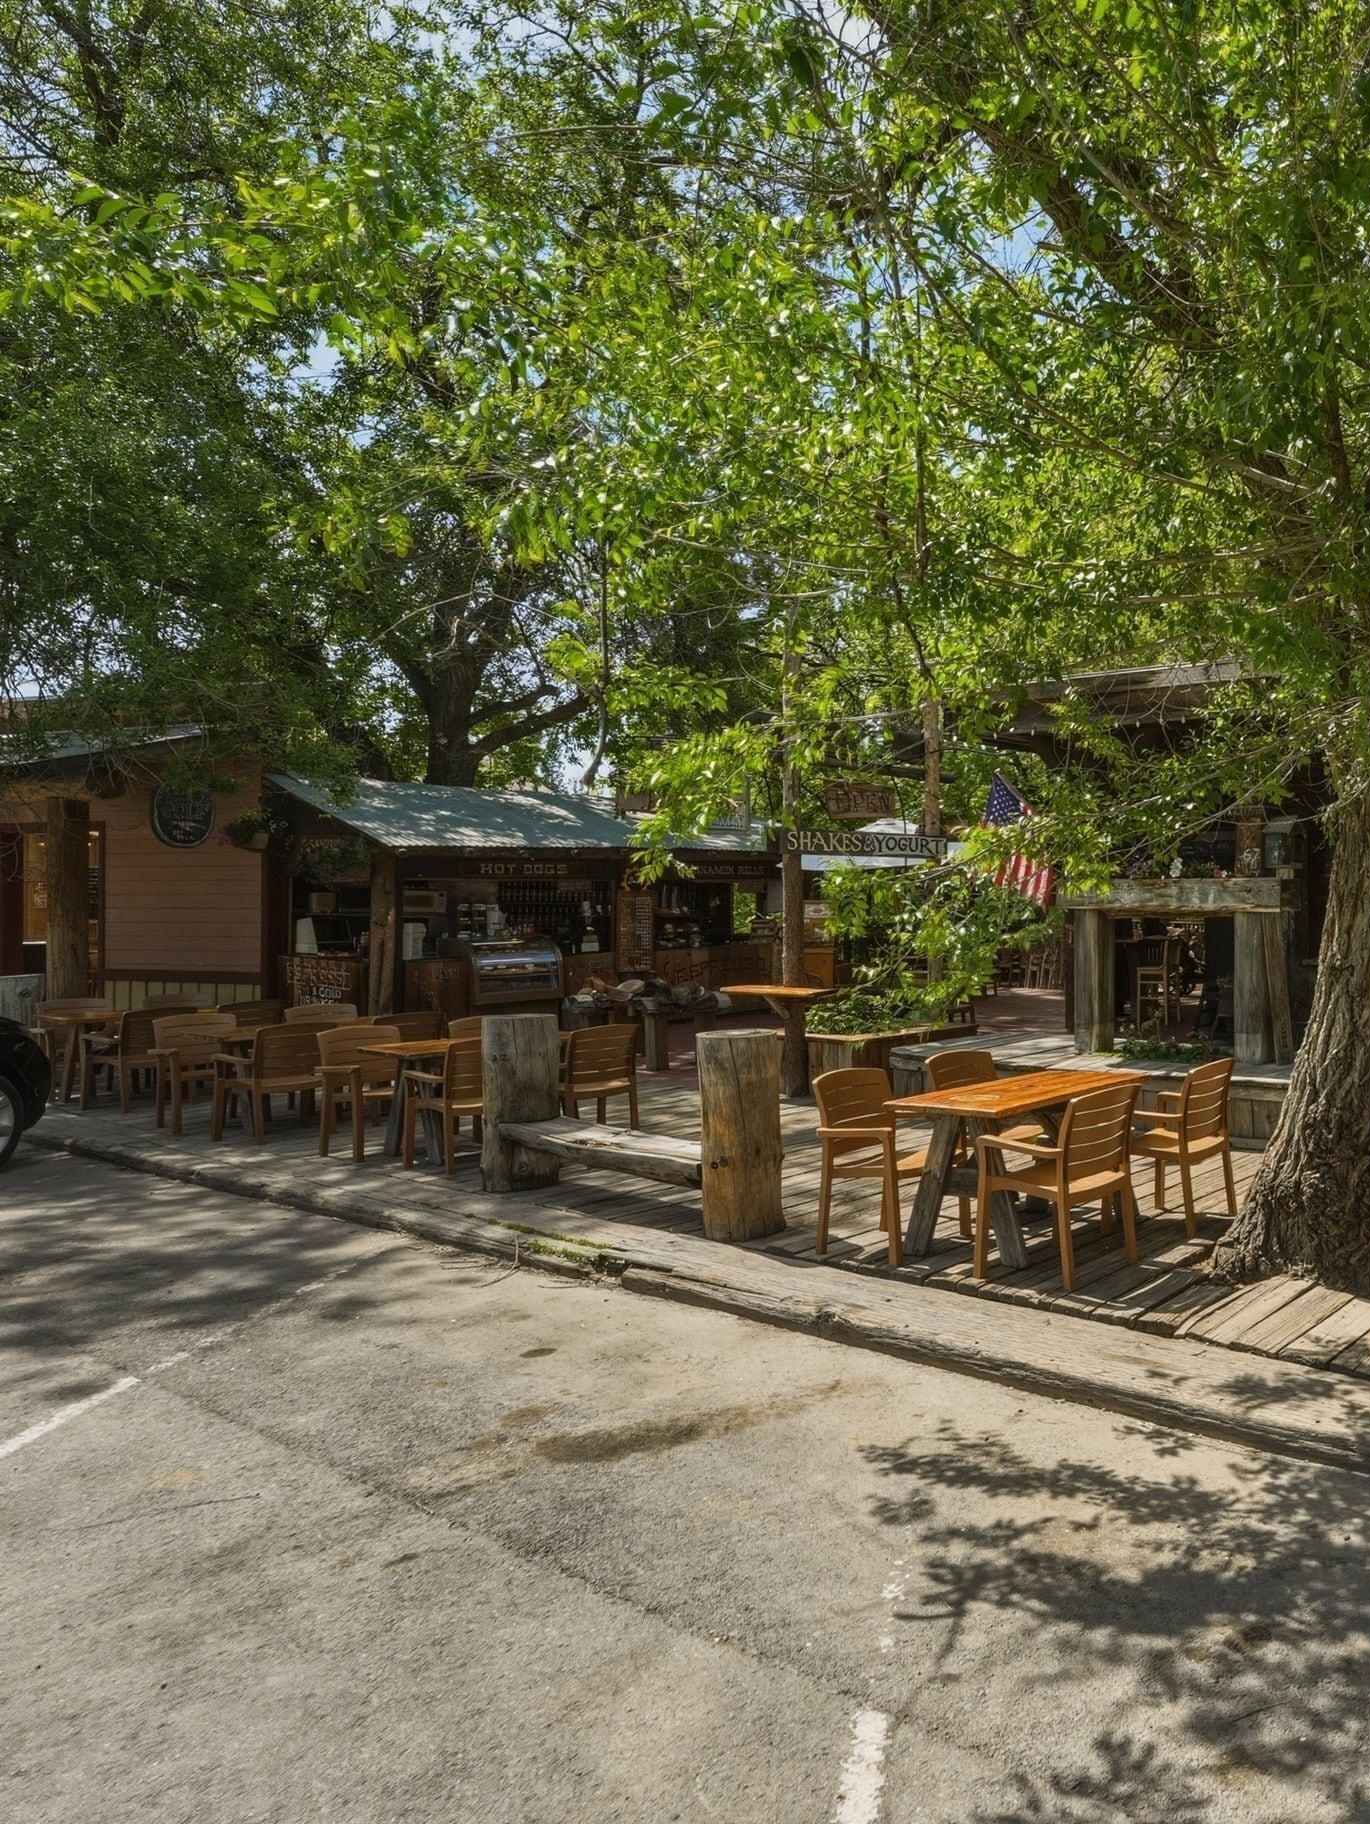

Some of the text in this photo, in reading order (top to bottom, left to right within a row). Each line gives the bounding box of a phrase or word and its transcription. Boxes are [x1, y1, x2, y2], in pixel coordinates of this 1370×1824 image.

[786, 830, 945, 856] SHAKES & YOGURT
[479, 863, 568, 875] HOT DOGS
[319, 987, 342, 999] COLD
